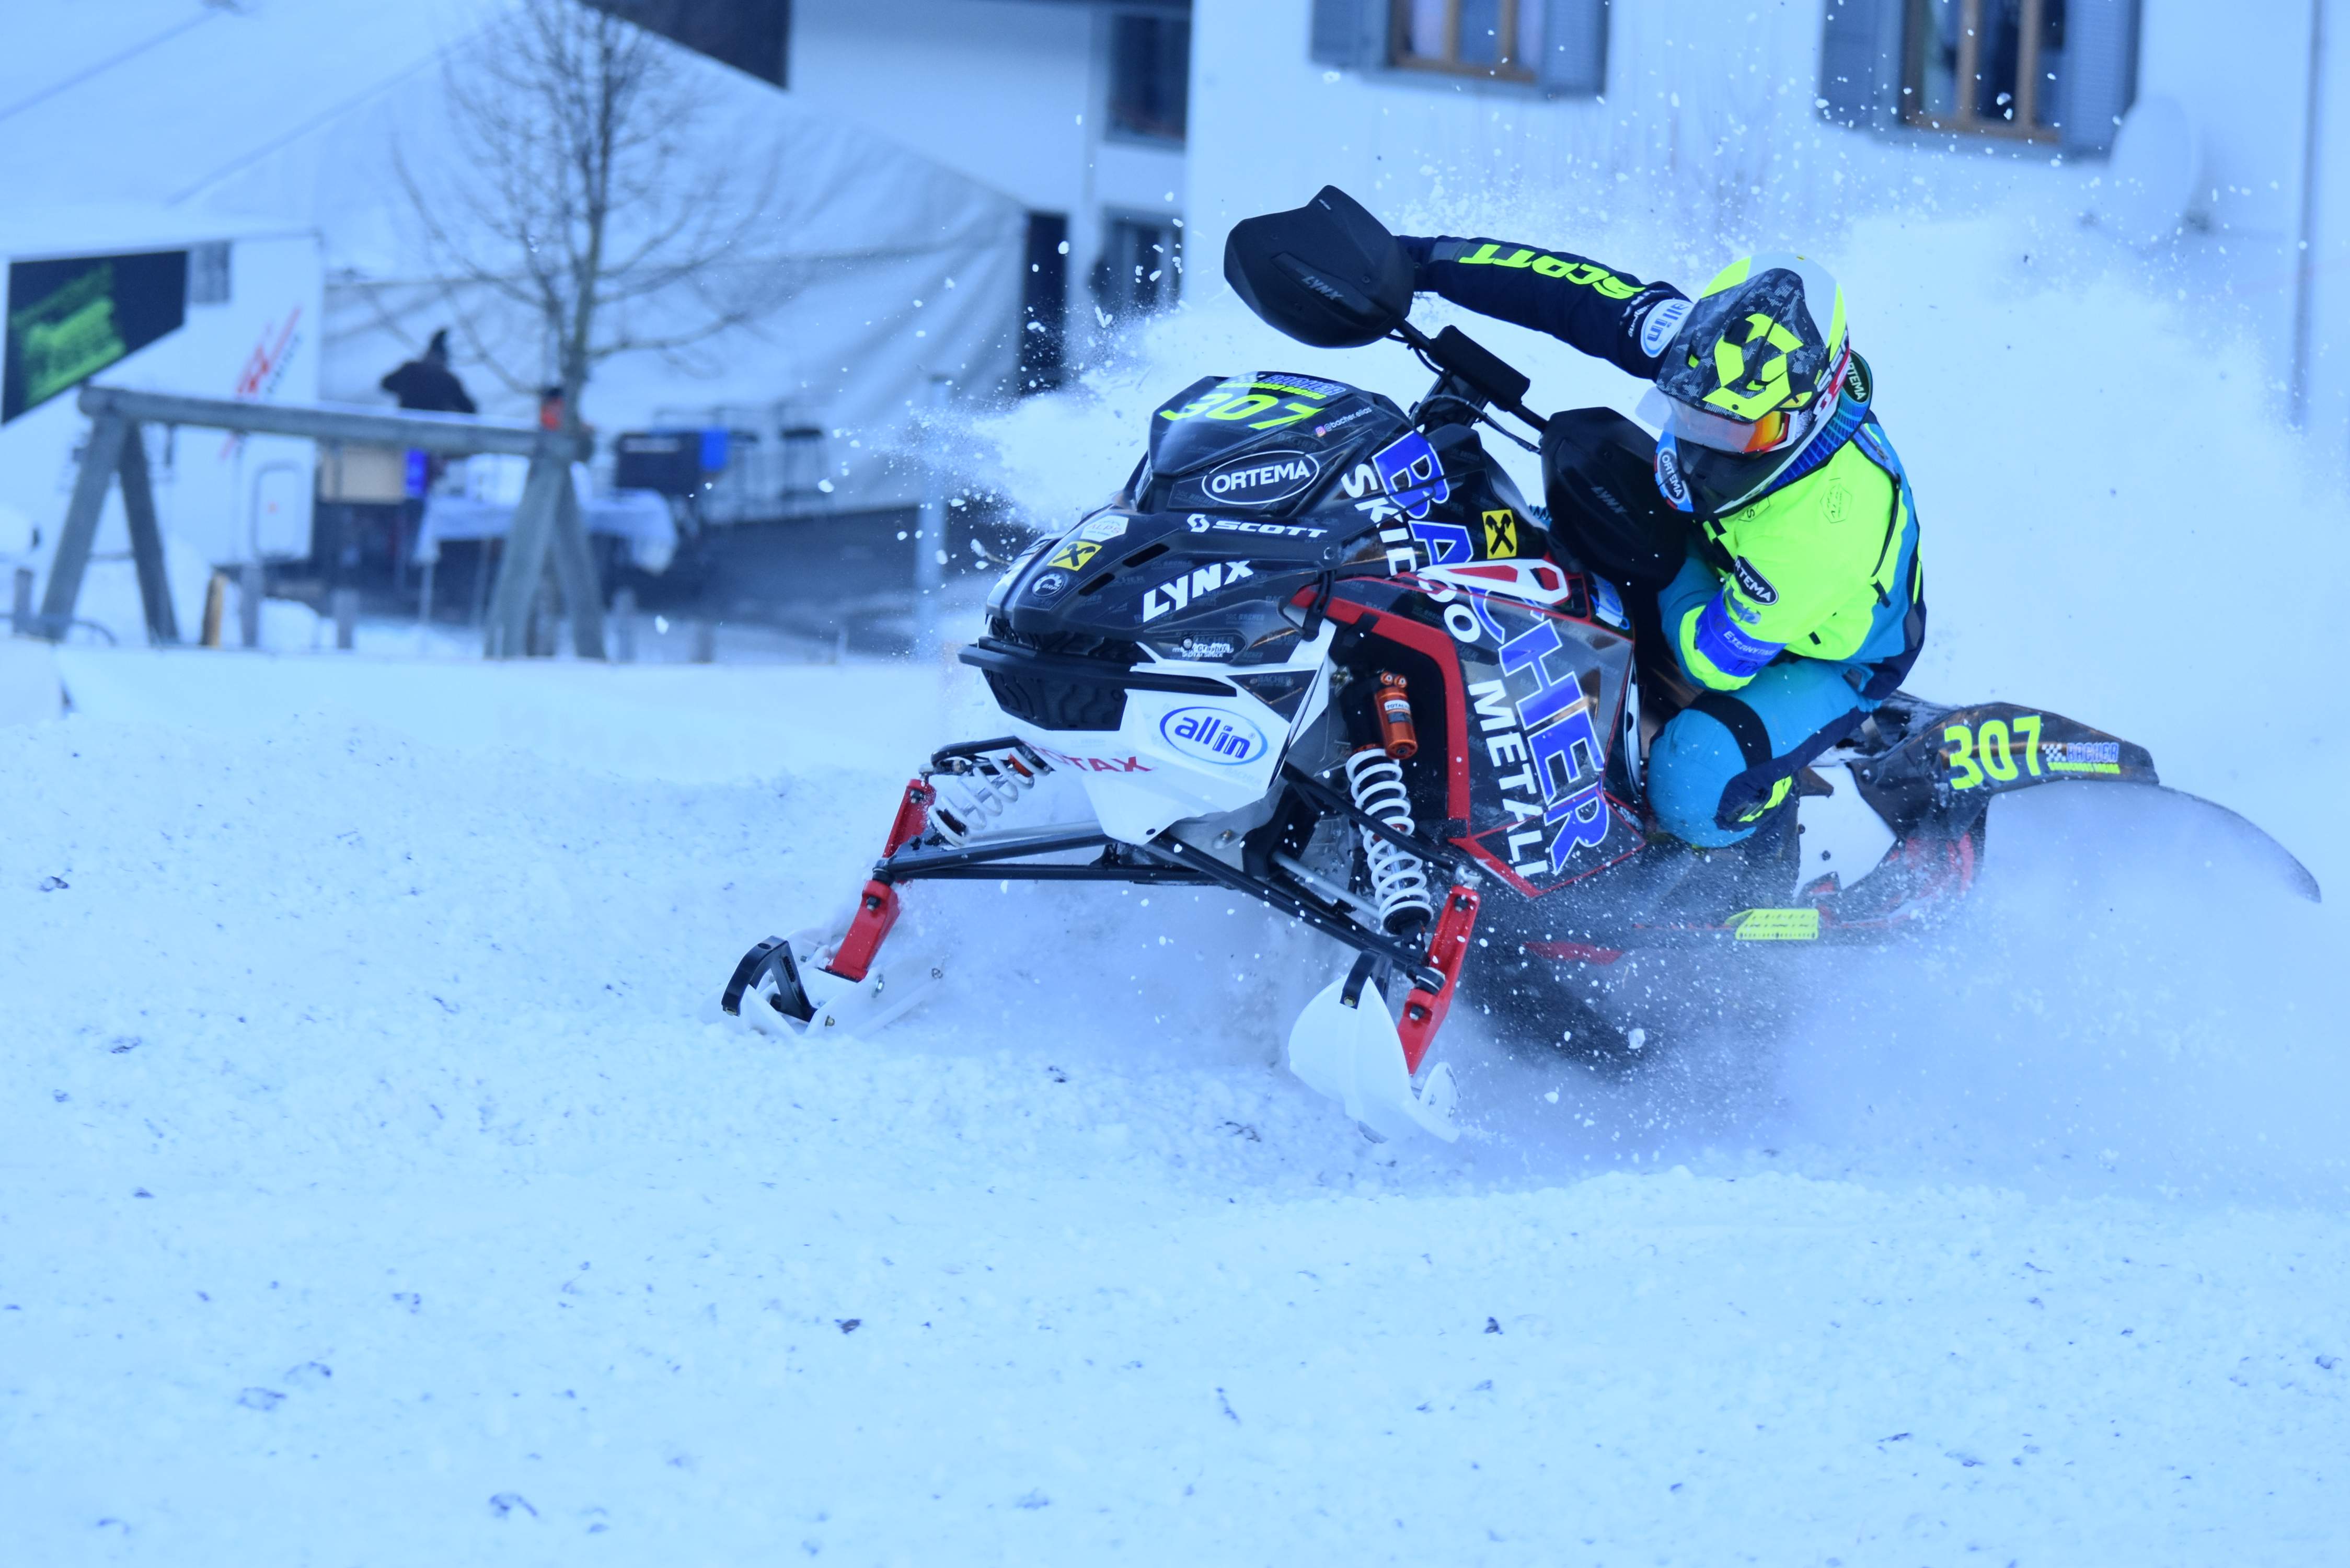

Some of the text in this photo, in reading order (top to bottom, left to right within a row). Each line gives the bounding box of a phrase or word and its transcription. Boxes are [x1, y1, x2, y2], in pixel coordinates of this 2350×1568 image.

[1301, 275, 1344, 301] LYNX
[1458, 244, 1646, 300] SCOTT
[1847, 356, 1867, 400] RTEMA
[1159, 393, 1326, 430] 307
[1211, 460, 1311, 493] ORTEMA
[1662, 454, 1683, 498] ORTEMA
[1212, 520, 1328, 538] SCOTT
[1143, 560, 1254, 623] LYNX
[1735, 559, 1771, 602] RTEMA
[1944, 714, 2042, 790] 307
